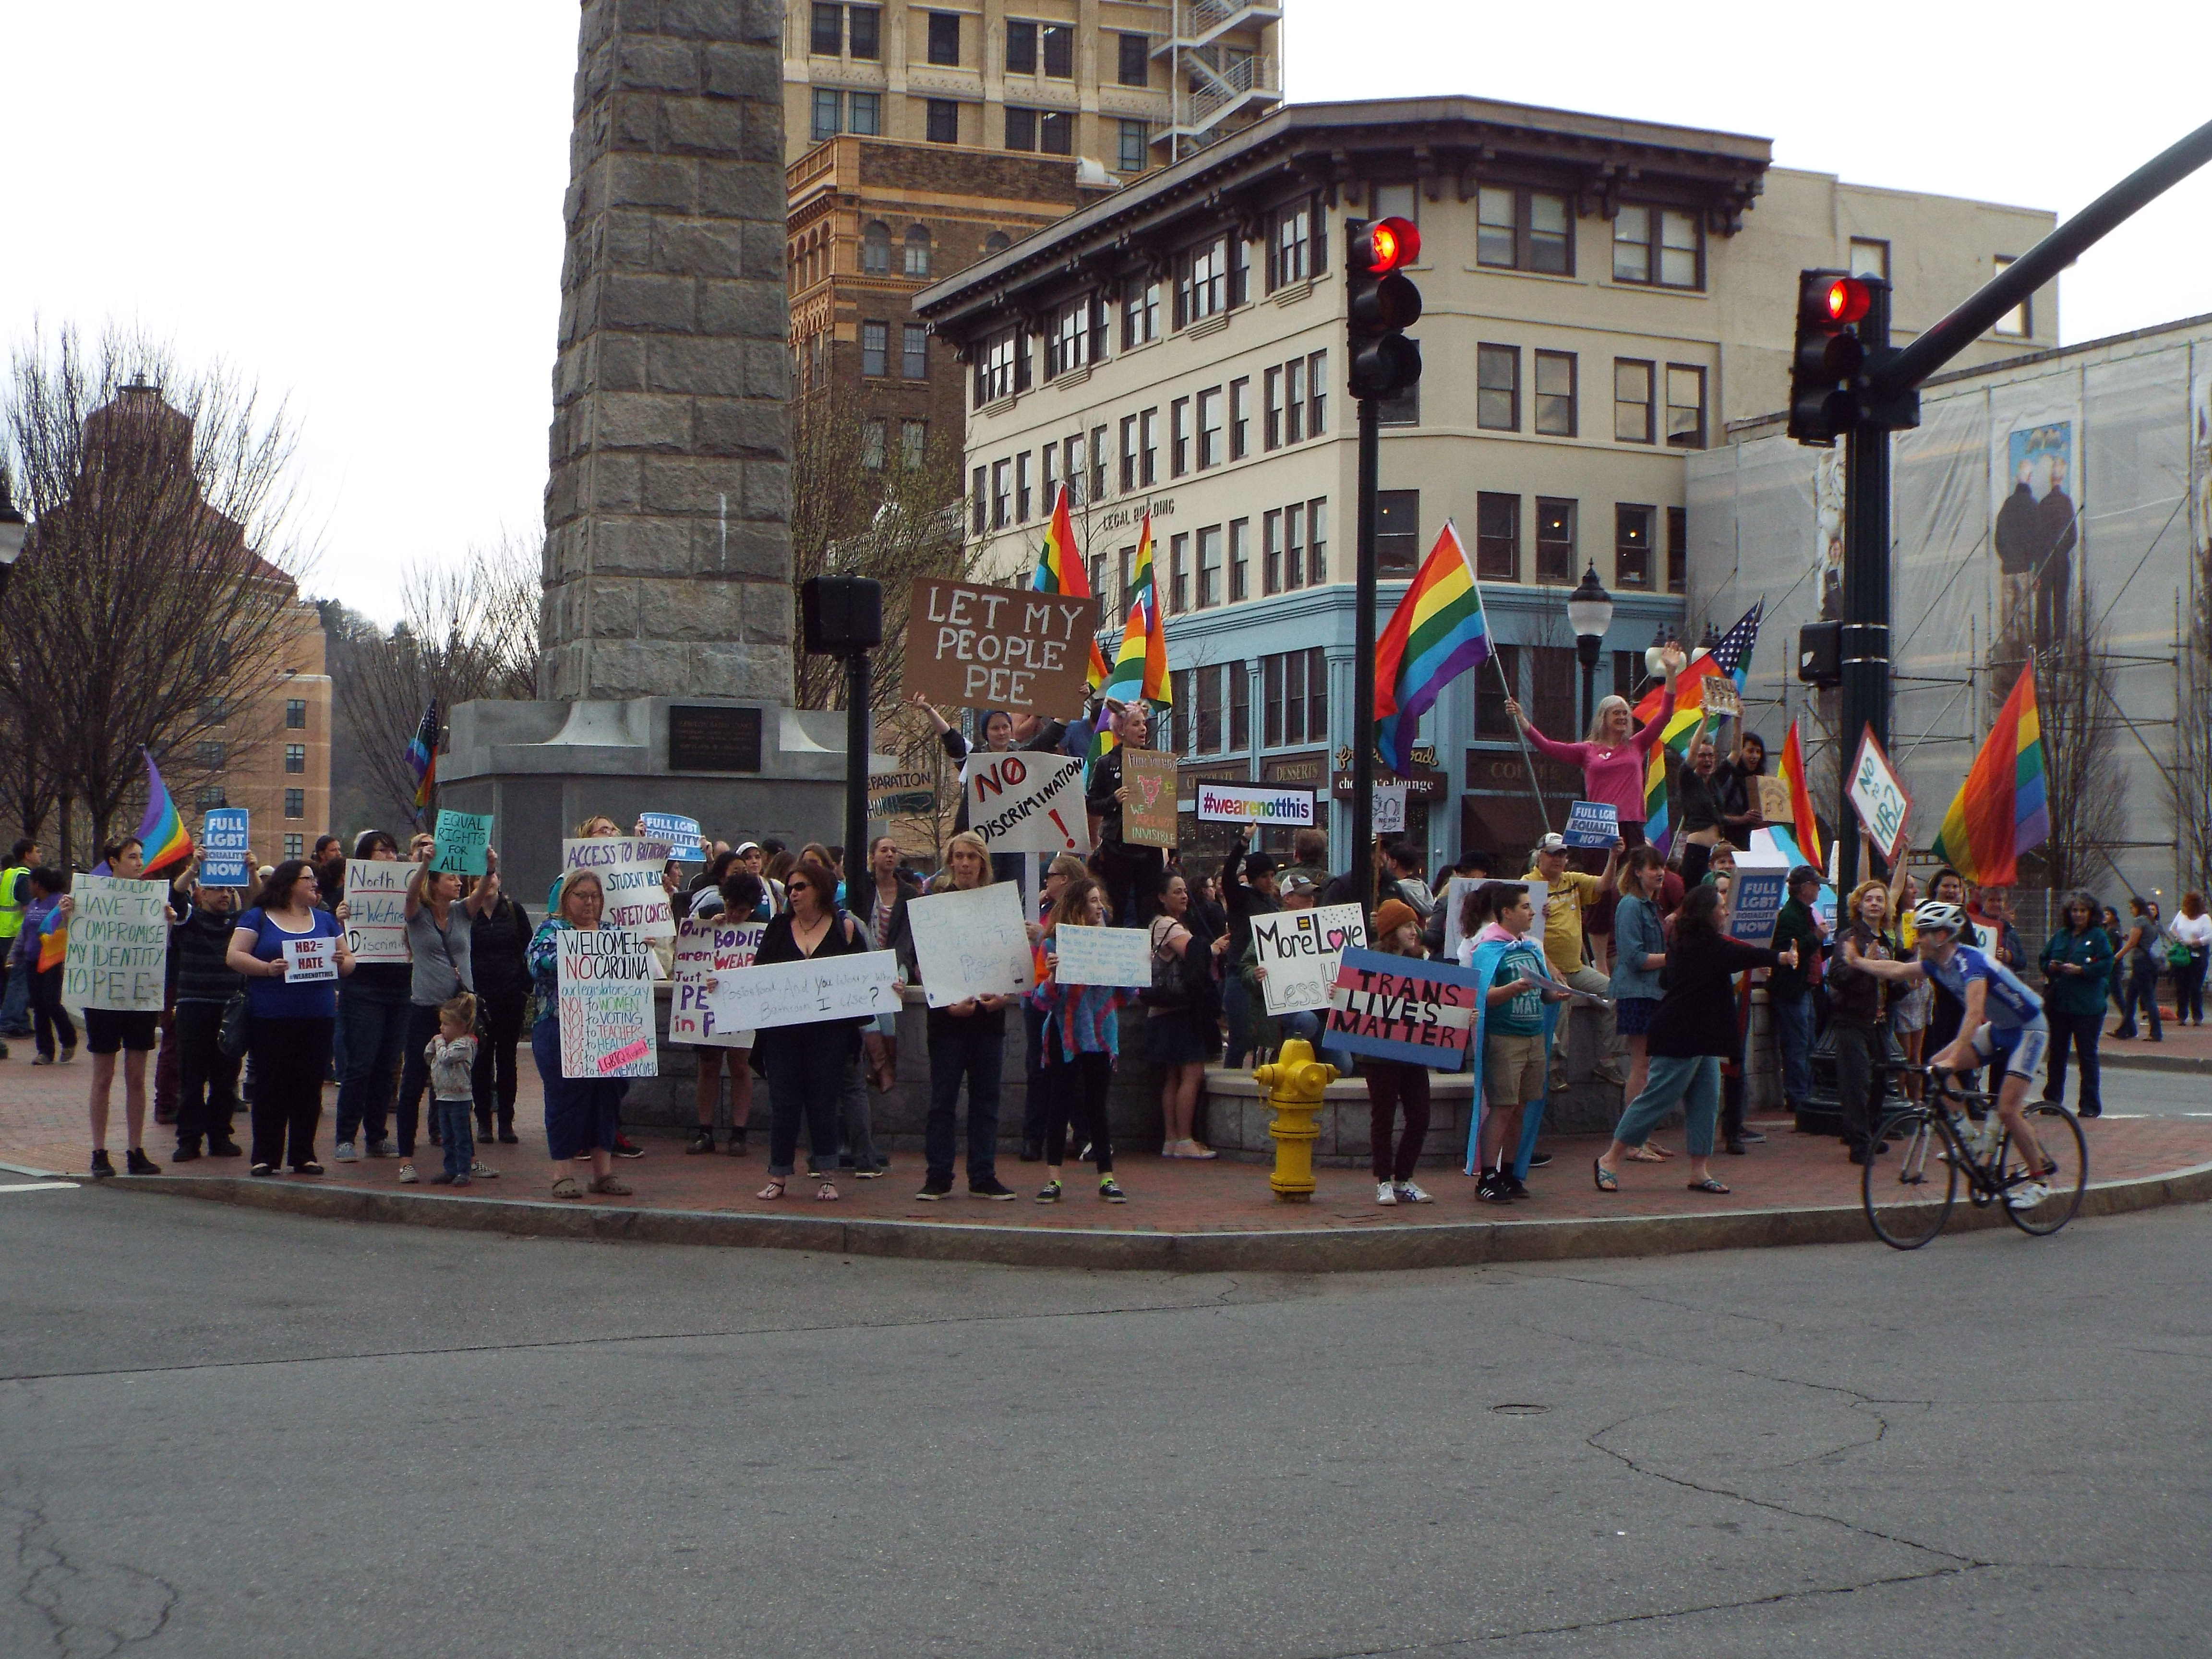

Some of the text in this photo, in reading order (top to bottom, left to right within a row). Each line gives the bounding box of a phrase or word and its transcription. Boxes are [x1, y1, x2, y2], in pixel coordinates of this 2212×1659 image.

[1104, 498, 1175, 530] LEGAL BUDING
[927, 587, 1084, 640] LET MY
[935, 627, 1067, 671] PEOPLE
[963, 664, 1036, 706] PEE
[974, 757, 1026, 803] NO
[1277, 764, 1319, 781] DESSERTS
[1859, 757, 1874, 795] NO
[1203, 792, 1310, 818] #wearenotthis
[1575, 807, 1597, 818] FULL
[208, 818, 244, 831] FULL
[444, 813, 485, 830] EQUAL
[647, 817, 697, 833] FULL LGBT
[1873, 784, 1904, 849] HB2
[1570, 819, 1616, 834] EQUALITY
[207, 833, 244, 846] LGBT
[437, 827, 485, 845] RIGHTS
[1132, 827, 1176, 845] INVISIBLE
[1579, 835, 1605, 844] NOW
[448, 845, 468, 855] FOR
[567, 843, 616, 868] ACCESS
[619, 842, 632, 862] TO
[670, 846, 686, 857] OW
[206, 864, 242, 876] NOW
[440, 856, 467, 871] ALL
[350, 865, 394, 889] North
[606, 872, 644, 891] STUDENT
[1745, 882, 1778, 894] FULL
[72, 893, 127, 916] HAVE
[135, 898, 160, 917] TO
[1742, 897, 1776, 908] LGBT
[609, 905, 643, 926] SAFETY
[70, 917, 165, 944] COMPROMISE
[680, 921, 765, 949] Our BODIE
[1736, 921, 1771, 933] NOW
[563, 932, 648, 956] WELCOME to
[1255, 920, 1316, 962] More
[67, 944, 164, 967] MY IDENTITY
[298, 957, 324, 969] HATE
[714, 953, 756, 971] WEAP
[565, 956, 592, 980] NO
[675, 971, 701, 982] Just
[66, 968, 150, 1004] TO PEE
[816, 975, 833, 995] You
[1263, 971, 1322, 1010] Less
[1358, 969, 1461, 1007] TRANS
[586, 998, 598, 1011] to
[599, 997, 639, 1011] WOMEN
[681, 985, 709, 1010] PE
[1346, 990, 1442, 1024] LIVES
[586, 1012, 599, 1025] to
[600, 1012, 643, 1025] VOTING
[674, 1015, 695, 1032] in
[587, 1026, 597, 1037] to
[597, 1025, 646, 1039] TEACHERS
[1333, 1011, 1455, 1048] MATTER
[585, 1039, 596, 1051] to
[598, 1038, 655, 1051] HEALTHE
[584, 1051, 595, 1063] to
[584, 1063, 595, 1076] to
